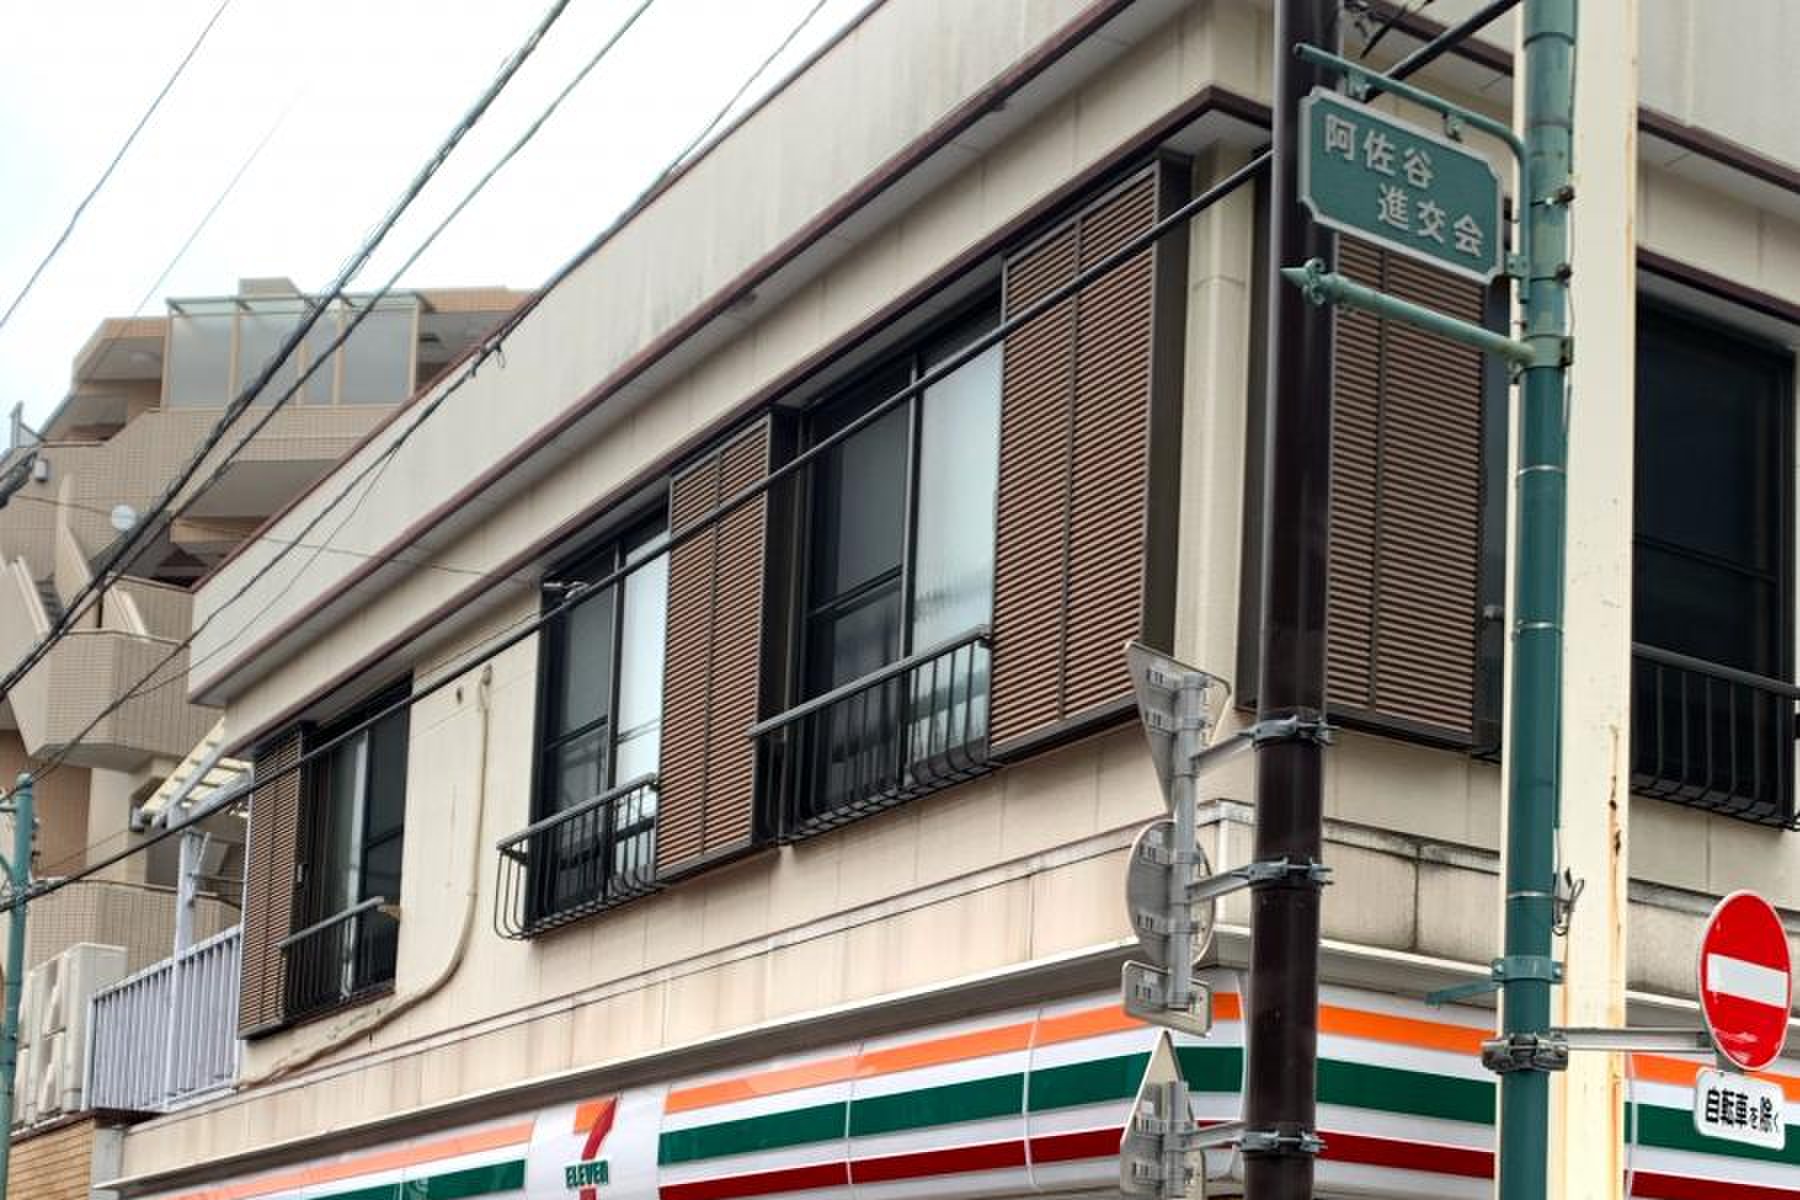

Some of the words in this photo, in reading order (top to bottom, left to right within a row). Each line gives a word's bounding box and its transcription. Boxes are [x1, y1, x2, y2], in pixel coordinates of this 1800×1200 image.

[1324, 113, 1434, 189] 阿佐谷
[1377, 183, 1484, 257] 進交会
